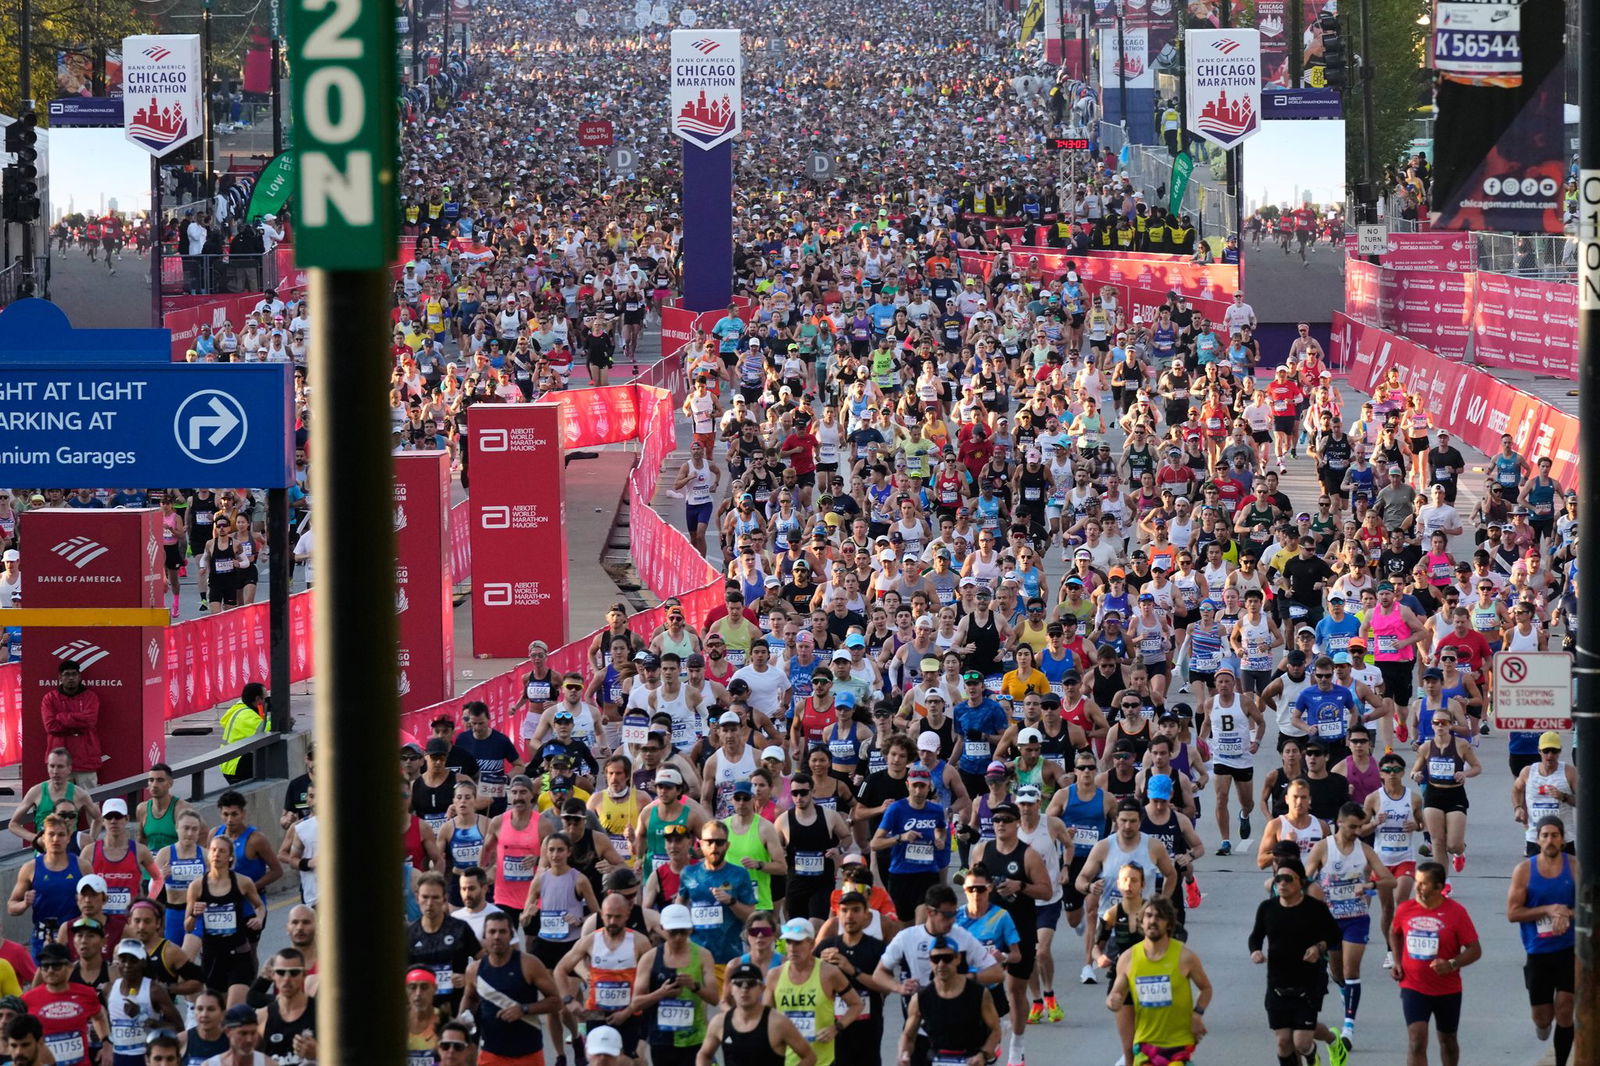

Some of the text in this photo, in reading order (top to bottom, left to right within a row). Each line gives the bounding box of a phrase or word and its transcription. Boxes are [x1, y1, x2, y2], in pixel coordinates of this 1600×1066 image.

[1436, 38, 1520, 57] K 56544
[677, 65, 735, 77] CHICAGO
[1197, 64, 1256, 77] CHICAGO
[128, 71, 187, 84] CHICAGO
[677, 78, 735, 87] MARATHON
[1197, 77, 1256, 87] MARATHON
[128, 84, 187, 94] MARATHON
[617, 150, 632, 167] D
[814, 156, 828, 172] D
[266, 174, 286, 198] LOW
[1460, 200, 1558, 211] chicagomarathon.com
[43, 382, 72, 400] AT
[78, 382, 148, 400] LIGHT
[88, 412, 117, 430] AT
[0, 446, 136, 470] nium Garages
[1500, 689, 1554, 697] NO STOPPING
[1500, 698, 1555, 706] NO STANDING
[1221, 714, 1234, 732] B
[1320, 724, 1340, 732] C7626
[1501, 718, 1566, 729] TOW ZONE
[624, 730, 645, 738] 3:05
[481, 786, 503, 794] 3:05
[916, 820, 936, 829] asics
[1076, 831, 1098, 840] 15794
[796, 857, 823, 866] C18771
[172, 865, 203, 877] C21789
[106, 894, 128, 904] 8023
[207, 913, 233, 923] C2730
[1408, 938, 1437, 948] C21612
[598, 988, 626, 1000] C8678
[1140, 984, 1168, 996] C1676
[779, 994, 816, 1007] ALEX
[660, 1006, 690, 1020] C3779
[48, 1038, 82, 1054] 11755
